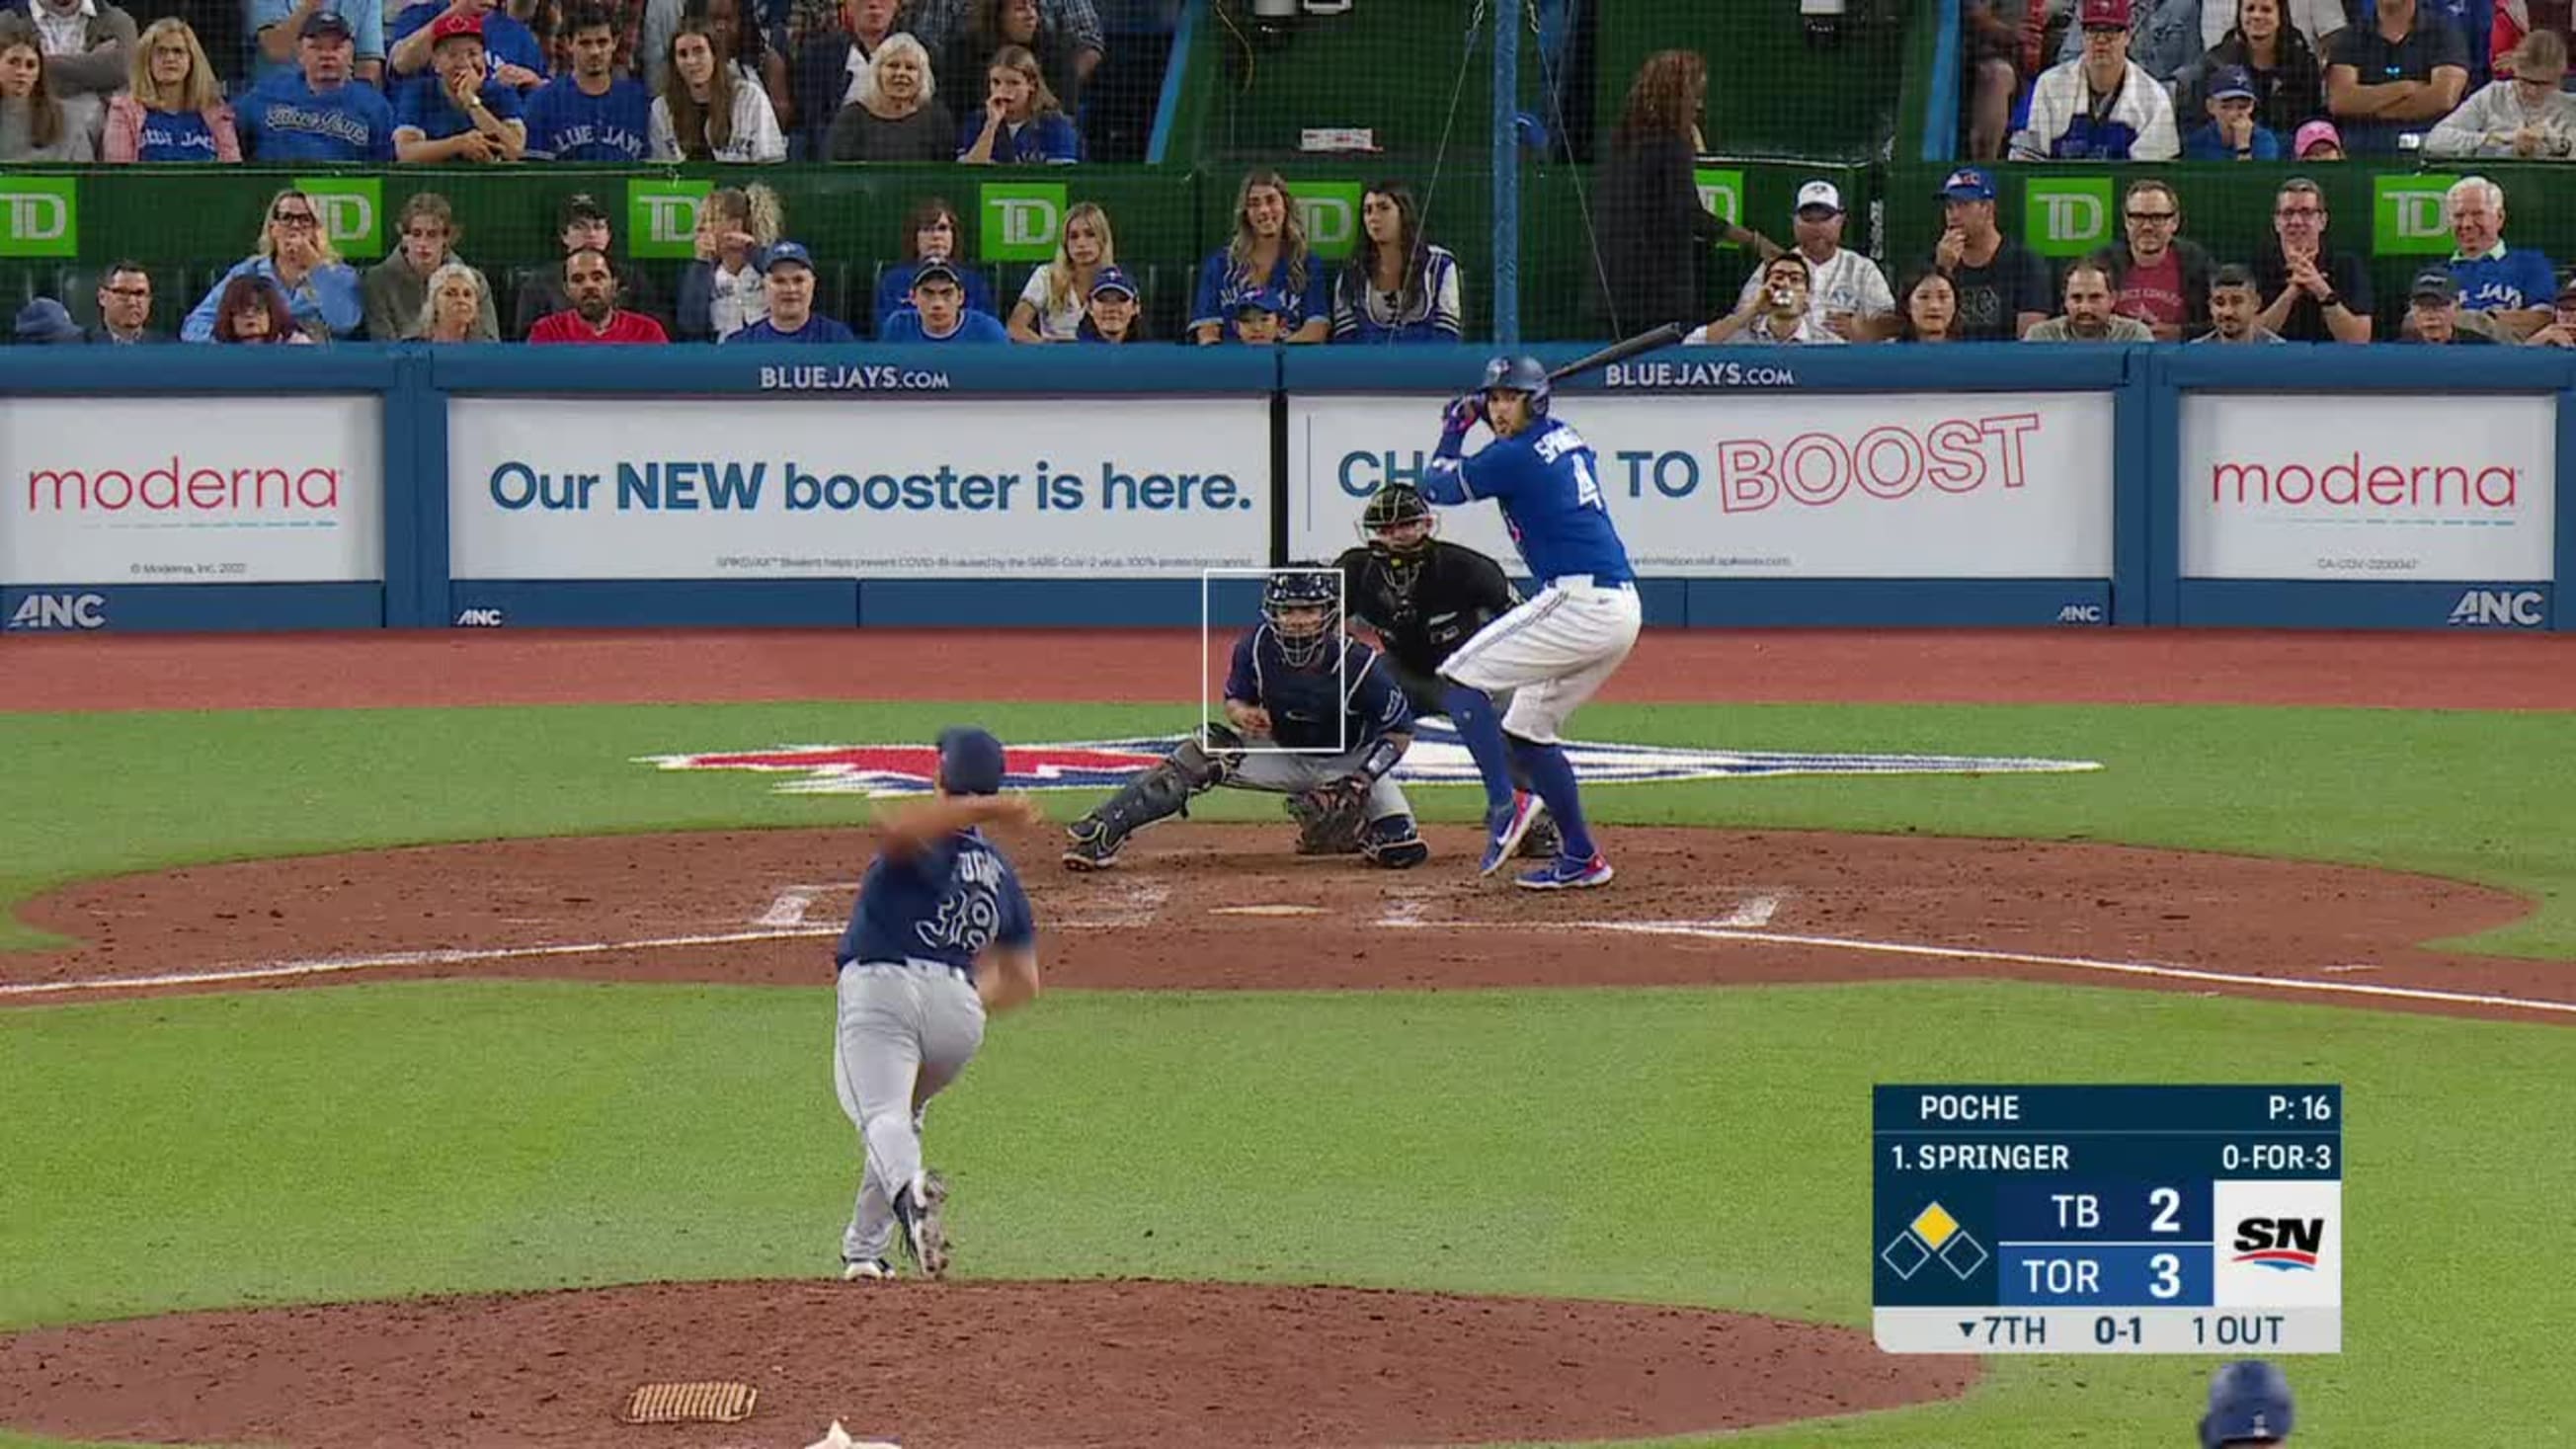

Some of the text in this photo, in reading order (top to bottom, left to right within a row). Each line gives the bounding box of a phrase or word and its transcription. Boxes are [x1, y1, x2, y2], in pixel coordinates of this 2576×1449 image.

[0, 193, 67, 240] TD
[638, 196, 700, 242] TD
[991, 198, 1058, 245] TD
[2034, 193, 2103, 240] TD
[2382, 190, 2449, 237] TD
[29, 457, 342, 512] moderna
[488, 459, 1252, 513] Our NEW booster is here.
[1618, 412, 2041, 514] TO BOOST
[2213, 451, 2519, 507] moderna
[8, 595, 105, 628] ANC
[456, 609, 503, 626] ANC
[2056, 605, 2102, 622] ANC
[2449, 591, 2544, 626] ANC
